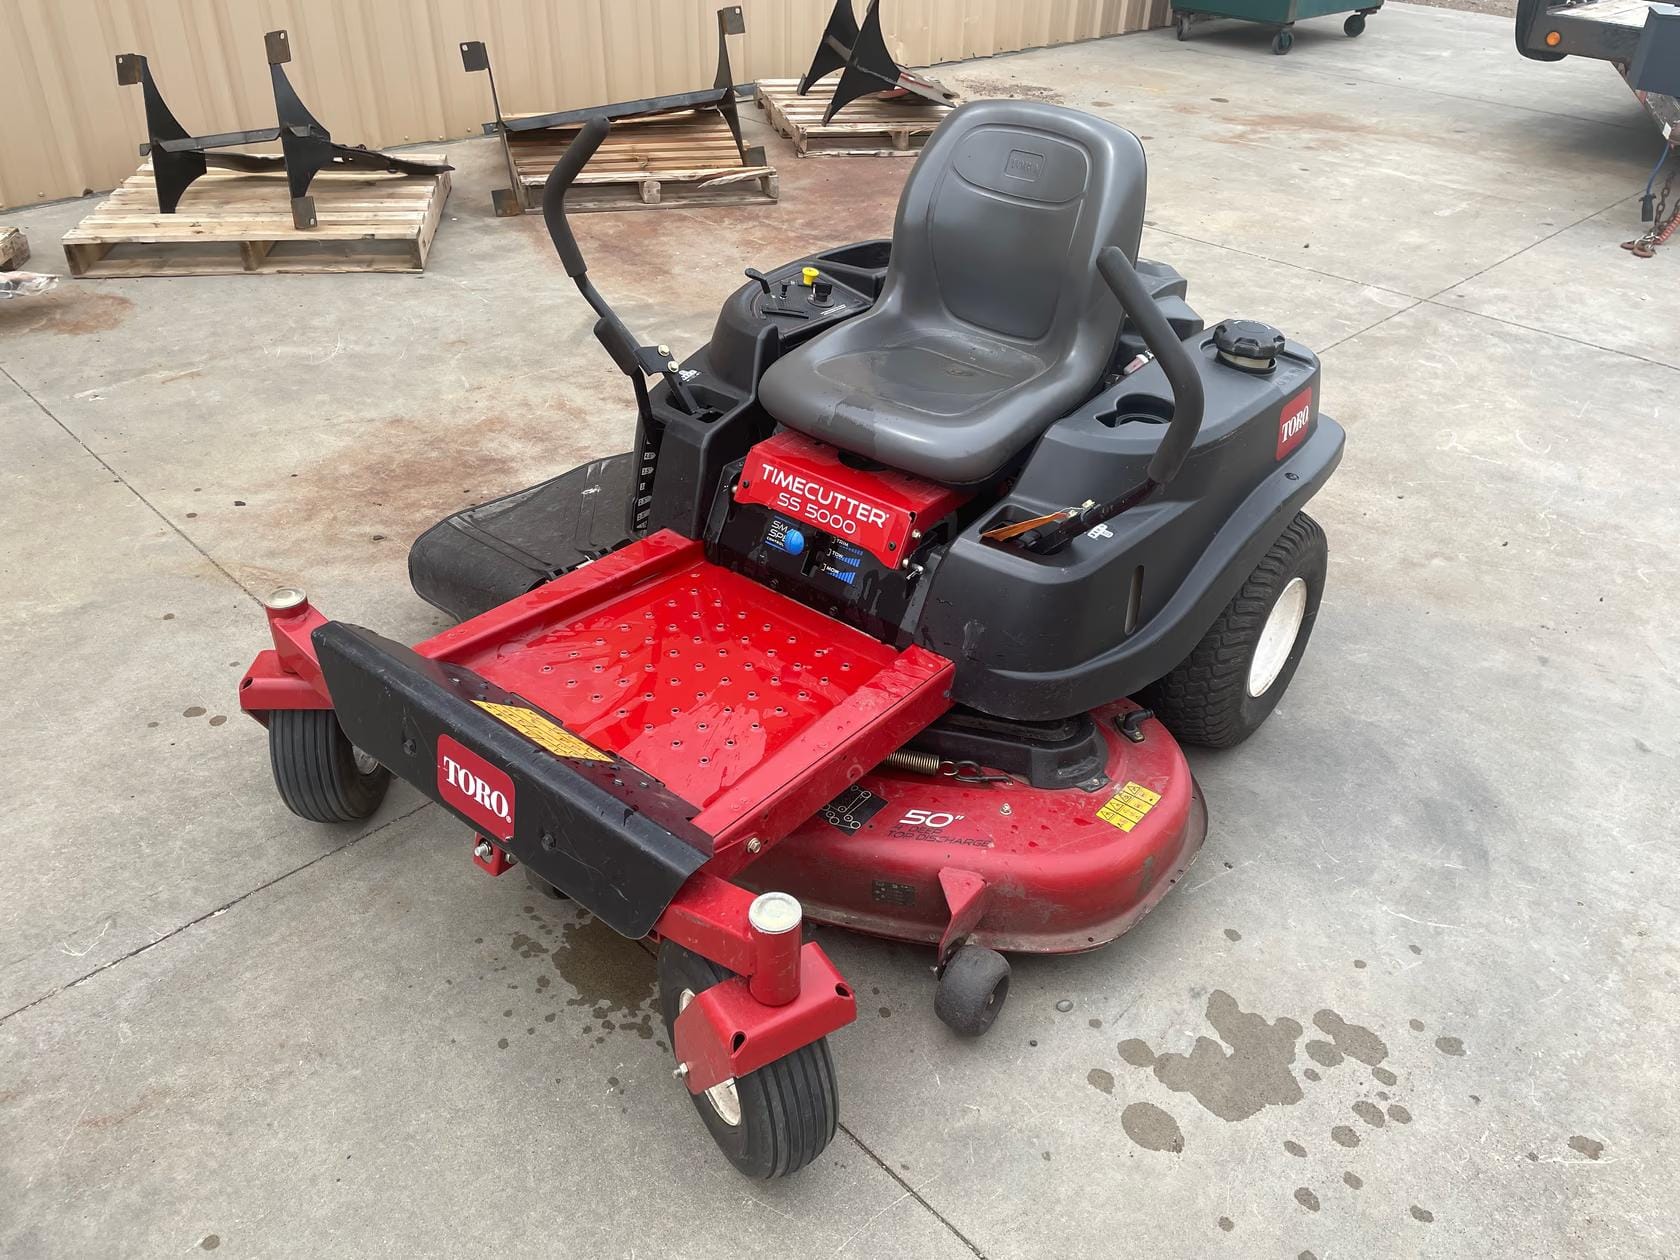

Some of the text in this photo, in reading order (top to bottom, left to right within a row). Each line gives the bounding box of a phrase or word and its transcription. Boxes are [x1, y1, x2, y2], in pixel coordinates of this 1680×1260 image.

[1281, 405, 1309, 443] TORO
[762, 463, 887, 529] TIMECUTTER
[777, 492, 856, 534] SS 5000
[771, 520, 788, 533] SM
[832, 550, 844, 558] TOW
[826, 565, 840, 574] MOW
[443, 755, 509, 819] TORO
[899, 809, 965, 828] 50"
[887, 830, 993, 848] TOP DISCHARGE
